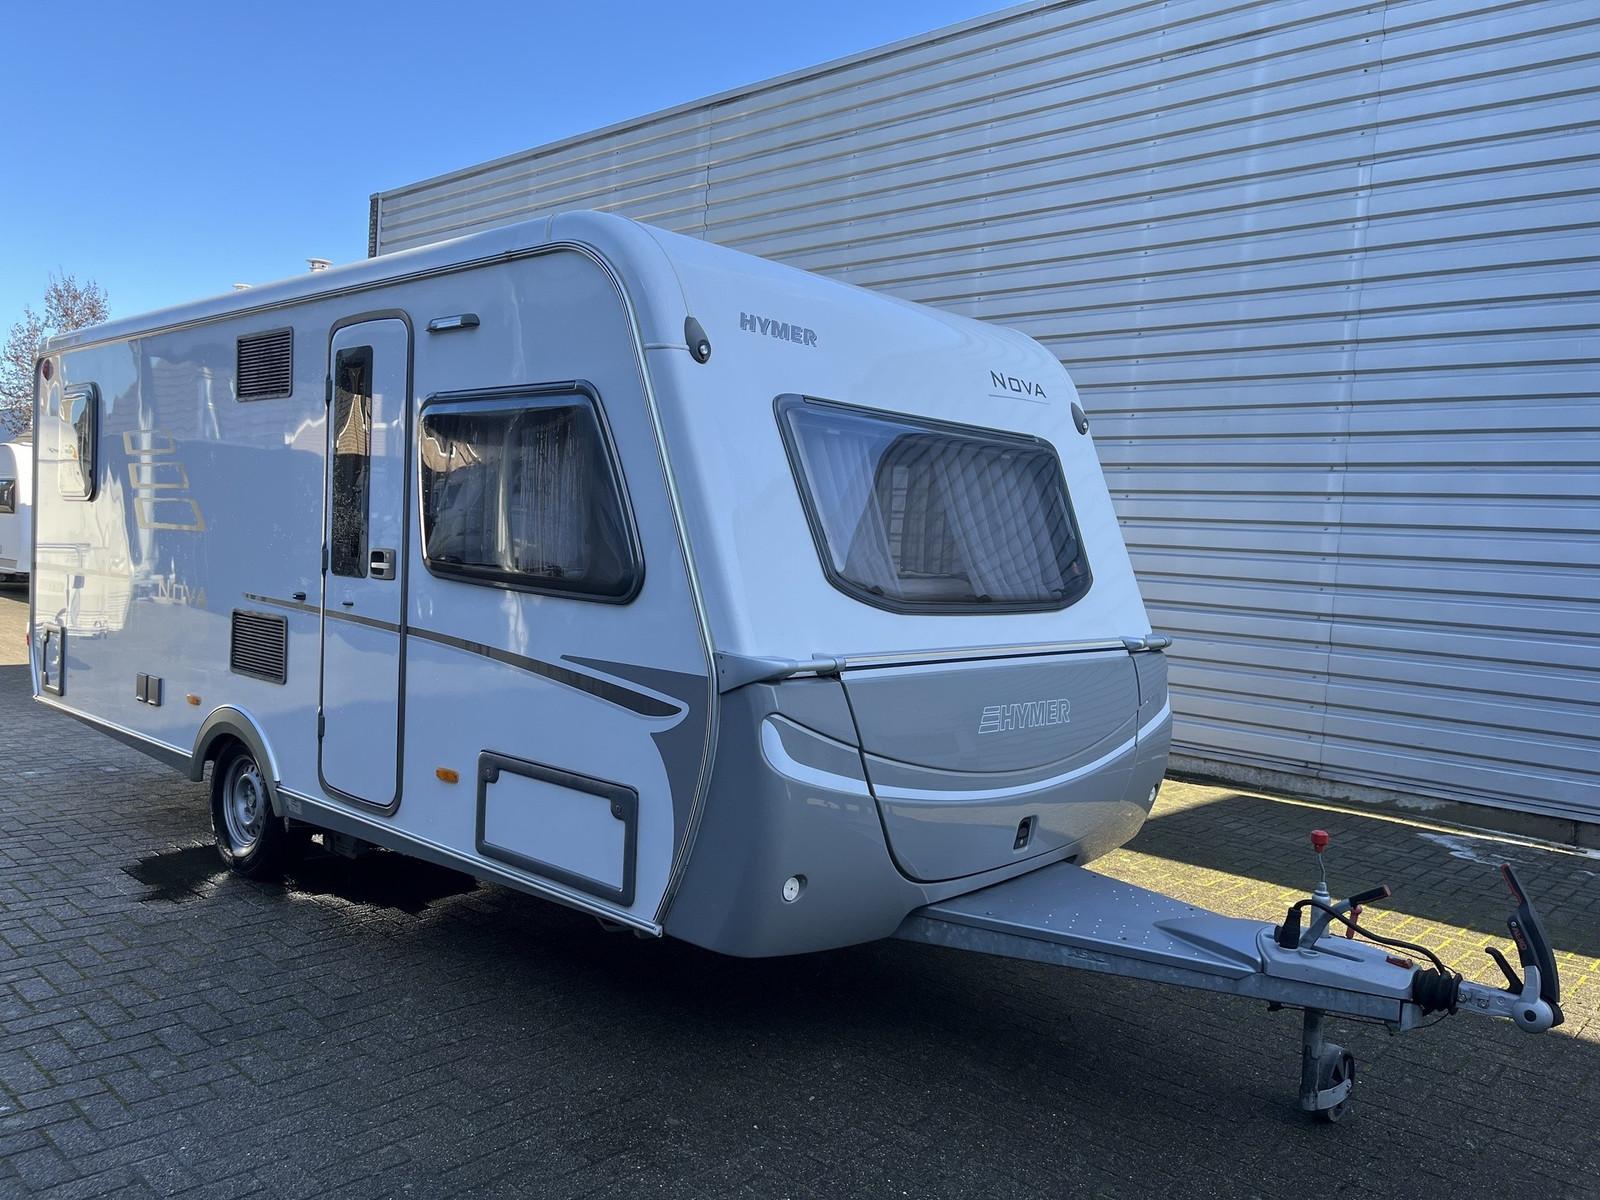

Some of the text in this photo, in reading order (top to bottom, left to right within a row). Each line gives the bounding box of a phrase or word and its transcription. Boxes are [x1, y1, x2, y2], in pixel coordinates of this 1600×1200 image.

[740, 311, 817, 348] HYMER
[990, 370, 1047, 399] NOVA
[999, 698, 1071, 732] HYMER
